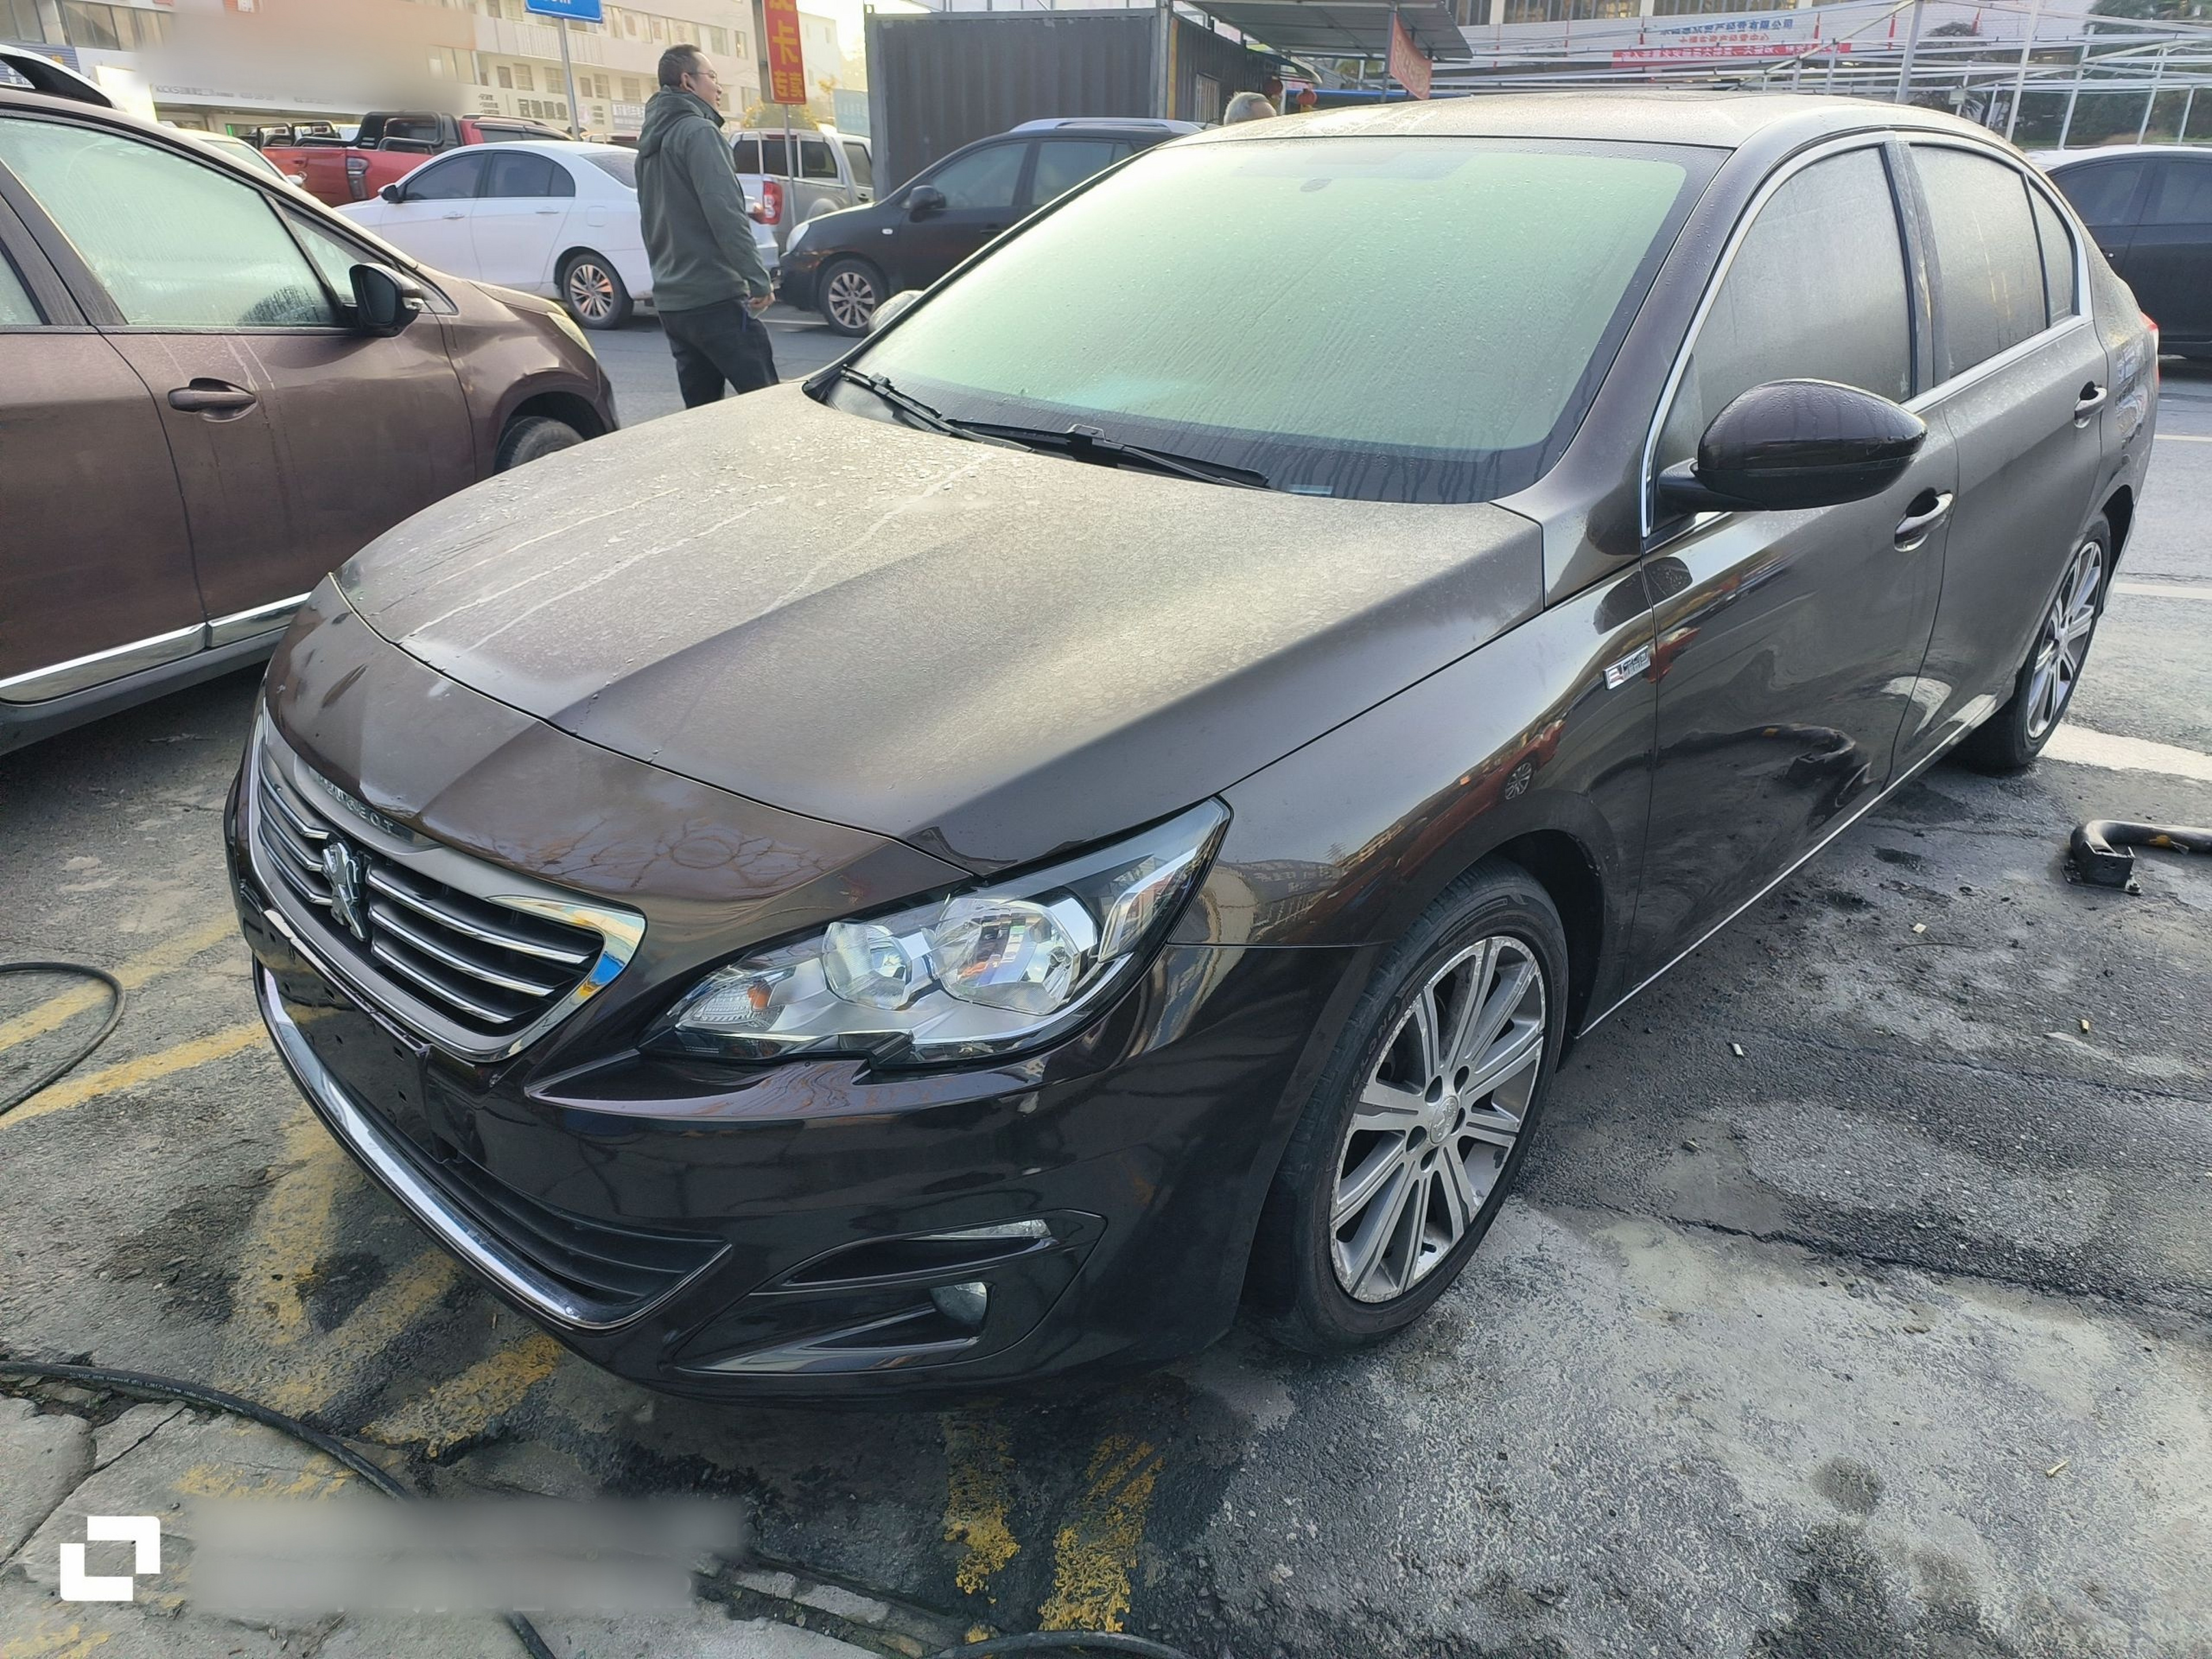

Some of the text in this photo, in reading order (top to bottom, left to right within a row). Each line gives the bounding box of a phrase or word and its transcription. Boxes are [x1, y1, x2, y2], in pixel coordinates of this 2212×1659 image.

[769, 0, 799, 65] 卡
[774, 70, 804, 98] 专卖
[319, 775, 393, 834] EUGEOT
